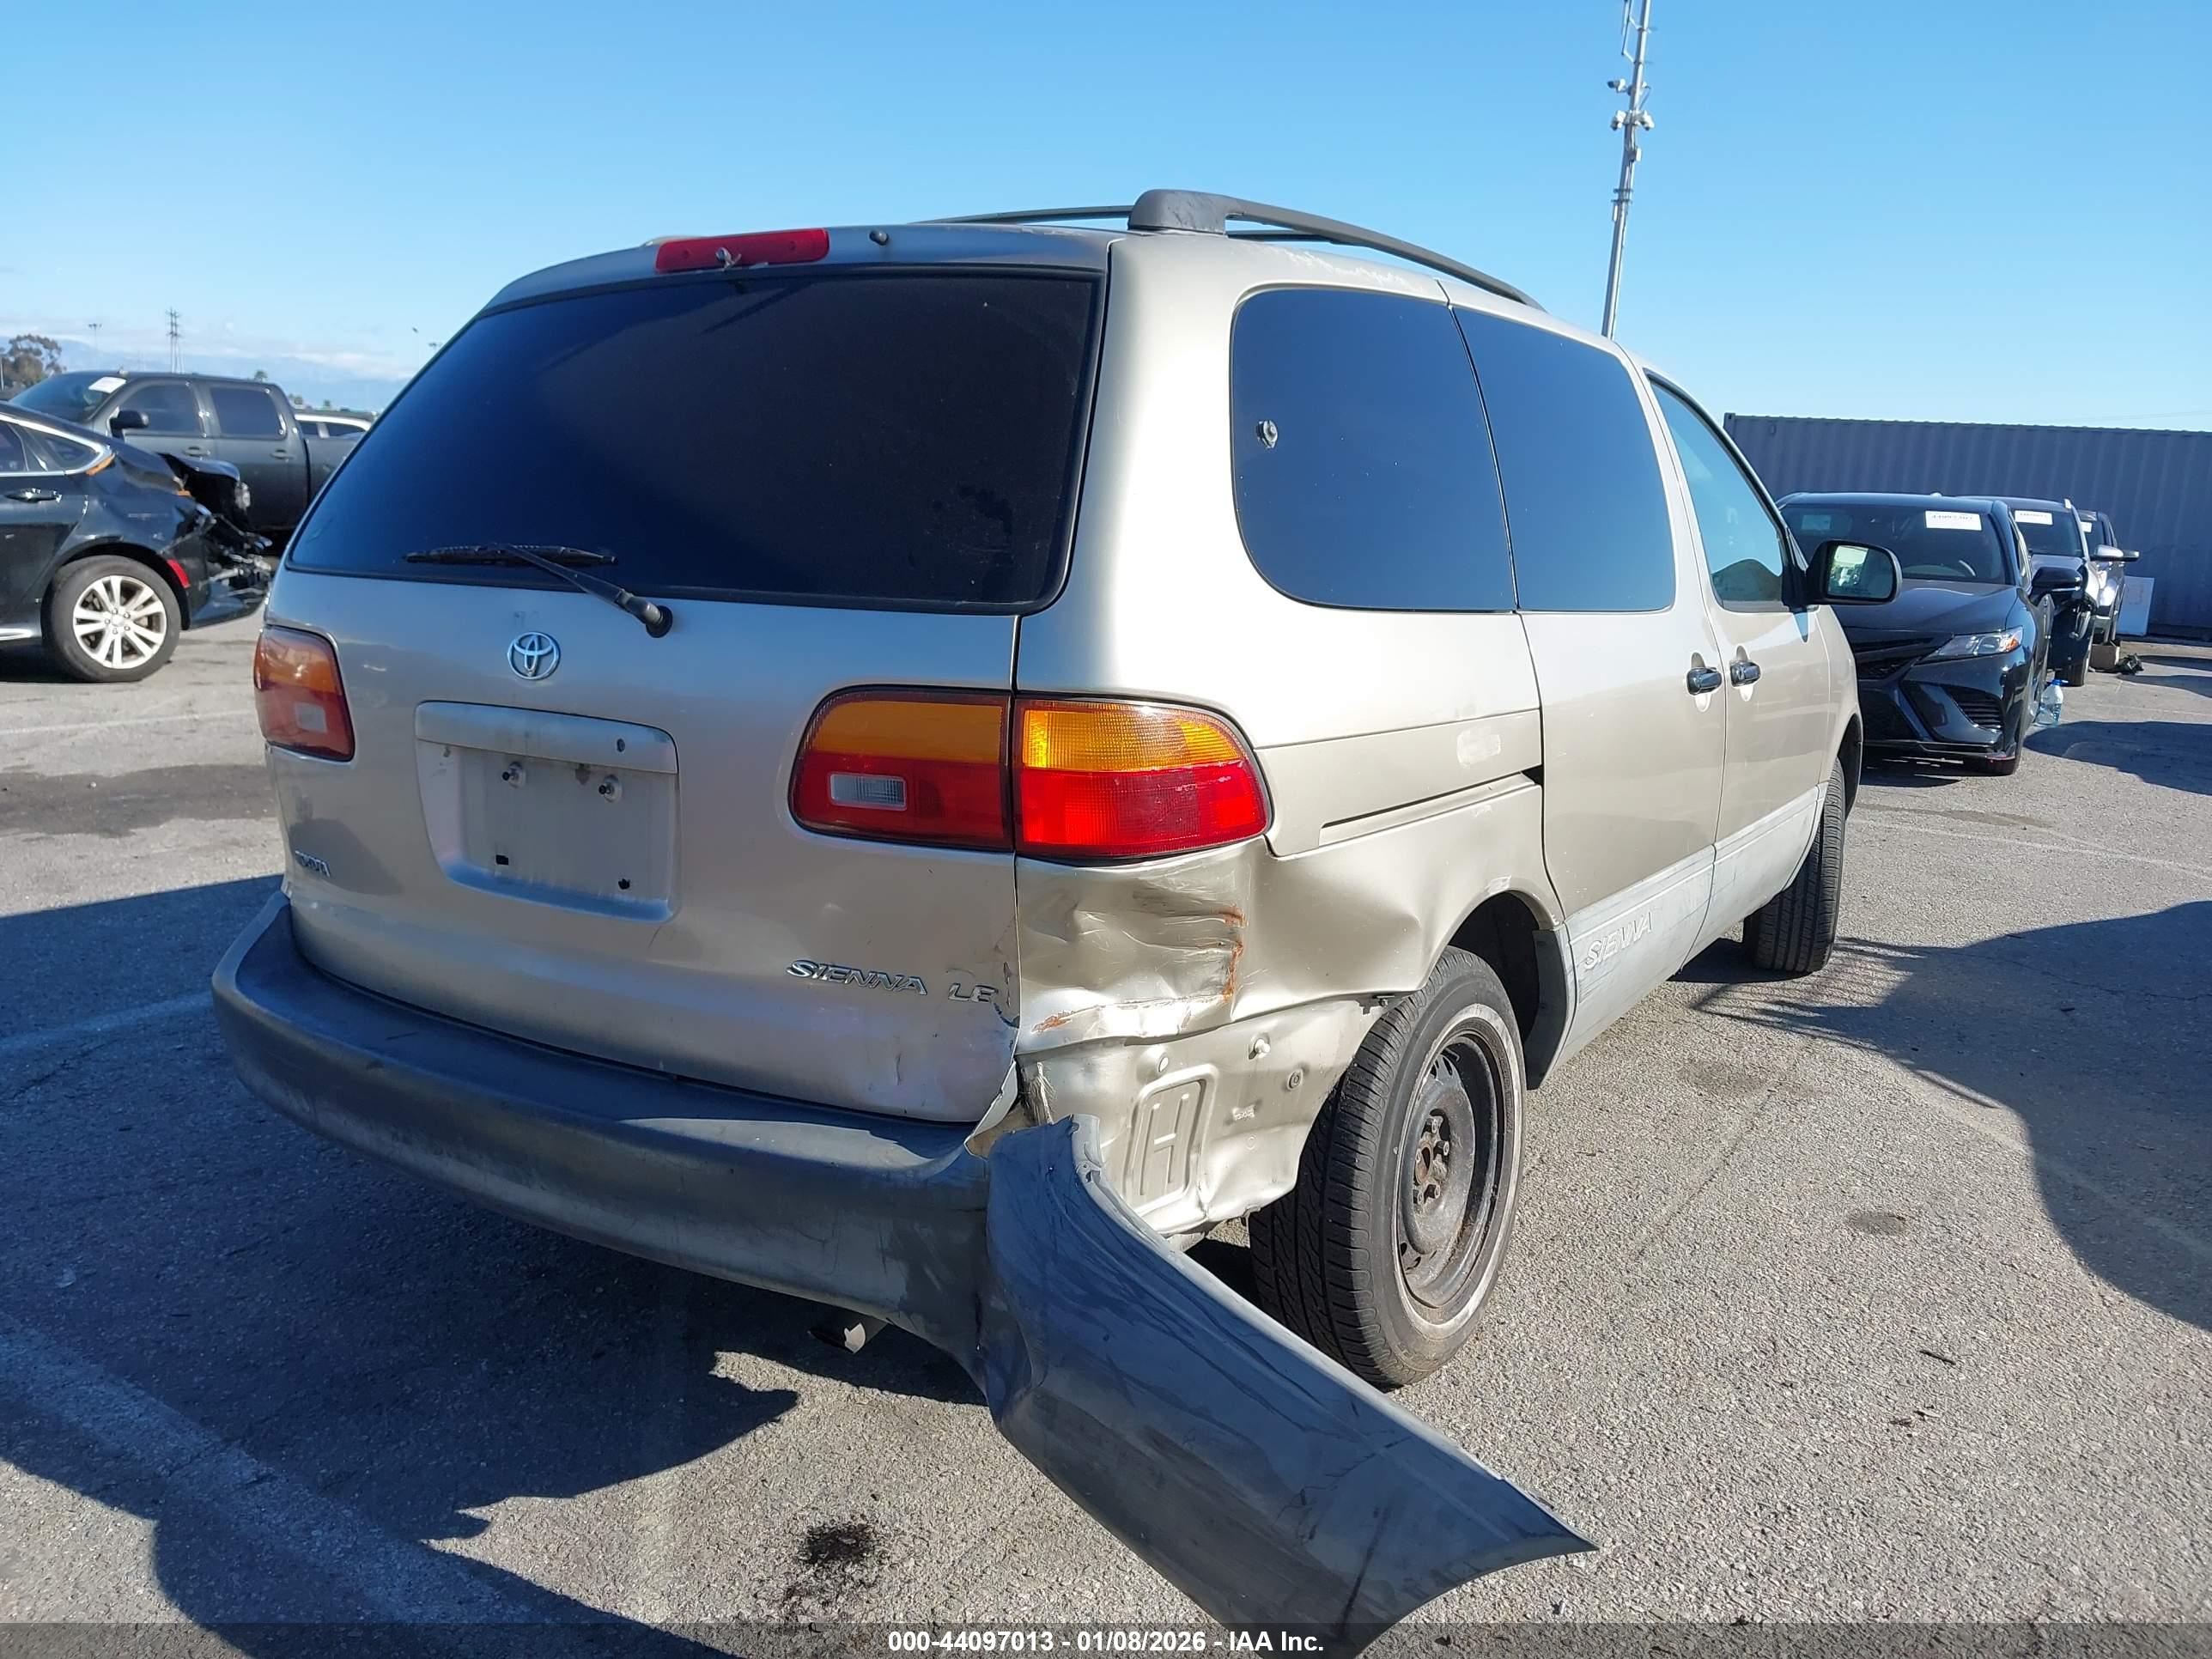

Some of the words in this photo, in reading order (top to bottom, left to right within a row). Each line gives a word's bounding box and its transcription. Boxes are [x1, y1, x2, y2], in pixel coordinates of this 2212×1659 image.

[1584, 912, 1653, 971] SIENNA
[787, 959, 927, 996] SIENNA
[948, 982, 999, 1003] LE
